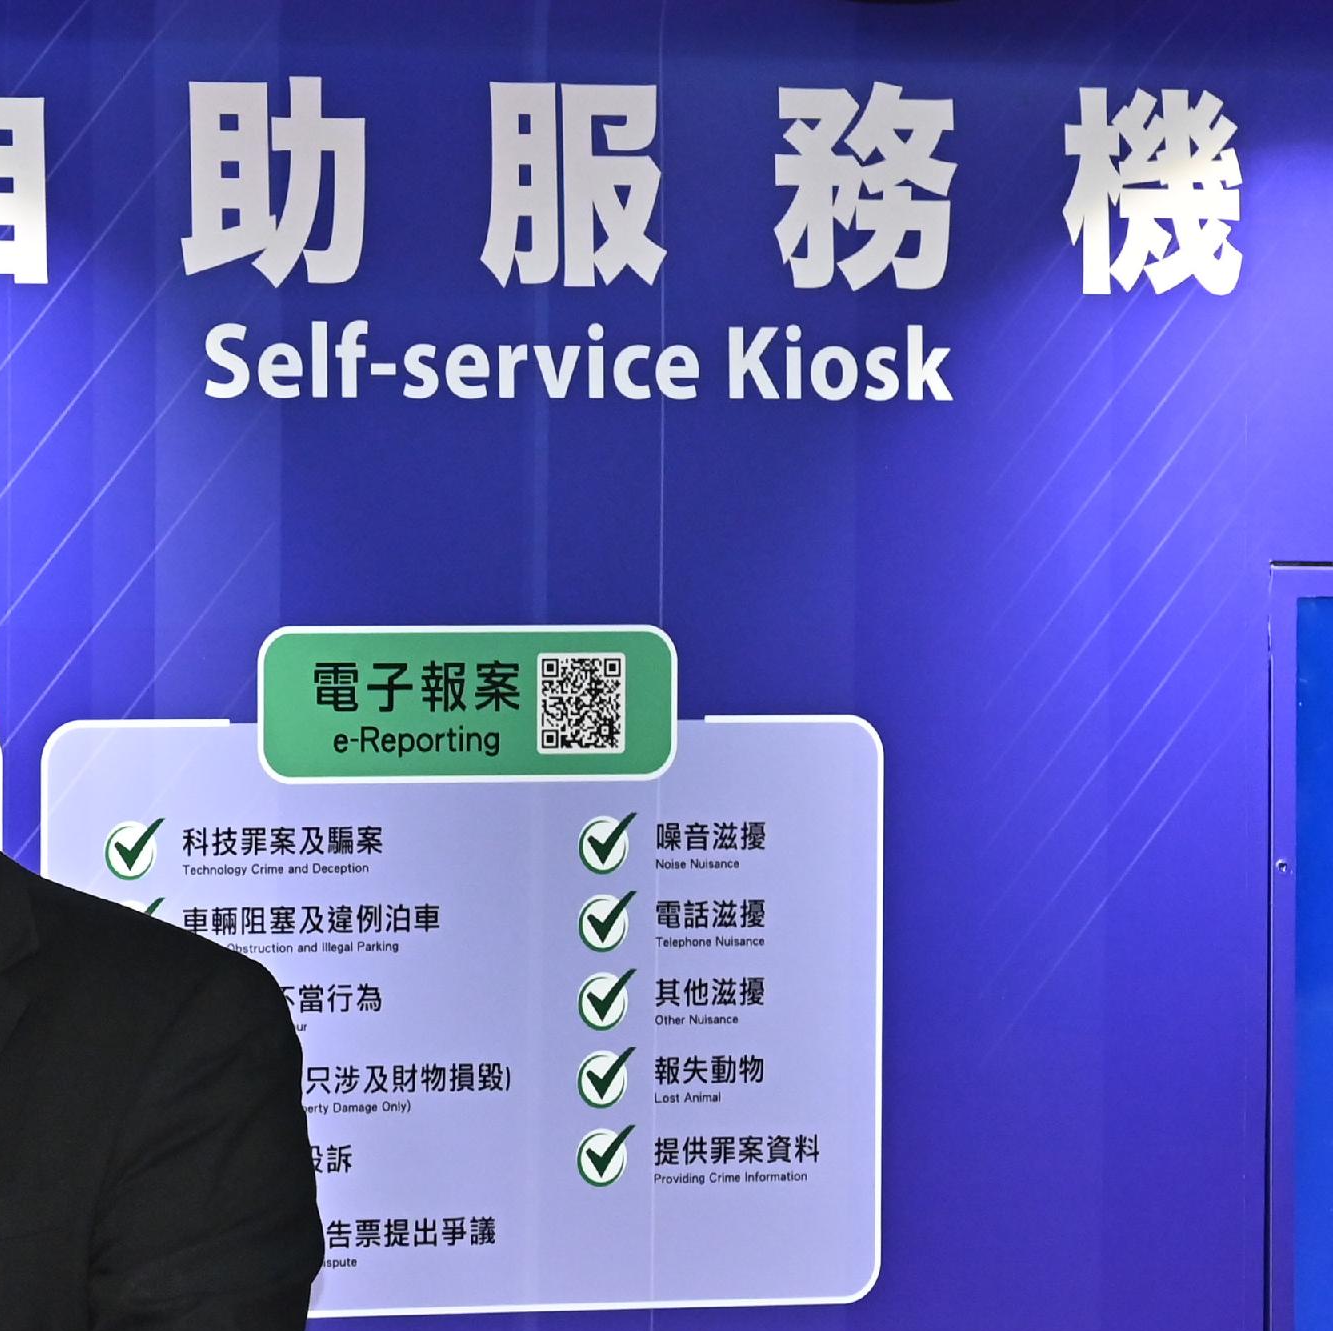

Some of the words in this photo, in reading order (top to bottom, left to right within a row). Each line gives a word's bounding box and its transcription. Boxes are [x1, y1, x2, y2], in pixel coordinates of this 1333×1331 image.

[203, 319, 700, 402] Self-service
[728, 324, 953, 402] Kiosk
[314, 660, 520, 712] 電子報案
[333, 725, 500, 758] e-Reporting
[182, 826, 383, 857] 科技罪案及騙案
[656, 821, 766, 851] 噪音滋擾
[182, 864, 248, 876] Technology
[251, 864, 284, 875] Crime
[288, 863, 309, 875] and
[312, 863, 369, 875] Deception
[655, 859, 687, 870] Noise
[690, 858, 740, 869] Nuisance
[183, 903, 440, 936] 車輛阻塞及違例泊車
[656, 899, 766, 929] 電話滋擾
[297, 942, 318, 953] and
[322, 942, 353, 954] Illegal
[357, 941, 399, 954] Parking
[655, 936, 712, 948] Telephone
[715, 935, 765, 947] Nuisance
[655, 977, 765, 1007] 其他滋擾
[654, 1014, 685, 1025] Other
[689, 1014, 739, 1025] Nuisance
[654, 1054, 764, 1085] 報失動物
[333, 1102, 378, 1115] Damage
[382, 1100, 412, 1115] Only)
[654, 1092, 680, 1104] Lost
[684, 1091, 721, 1103] Animal
[654, 1134, 820, 1166] 提供罪案資料
[654, 1172, 705, 1185] Providing
[709, 1172, 741, 1183] Crime
[745, 1171, 808, 1183] Information
